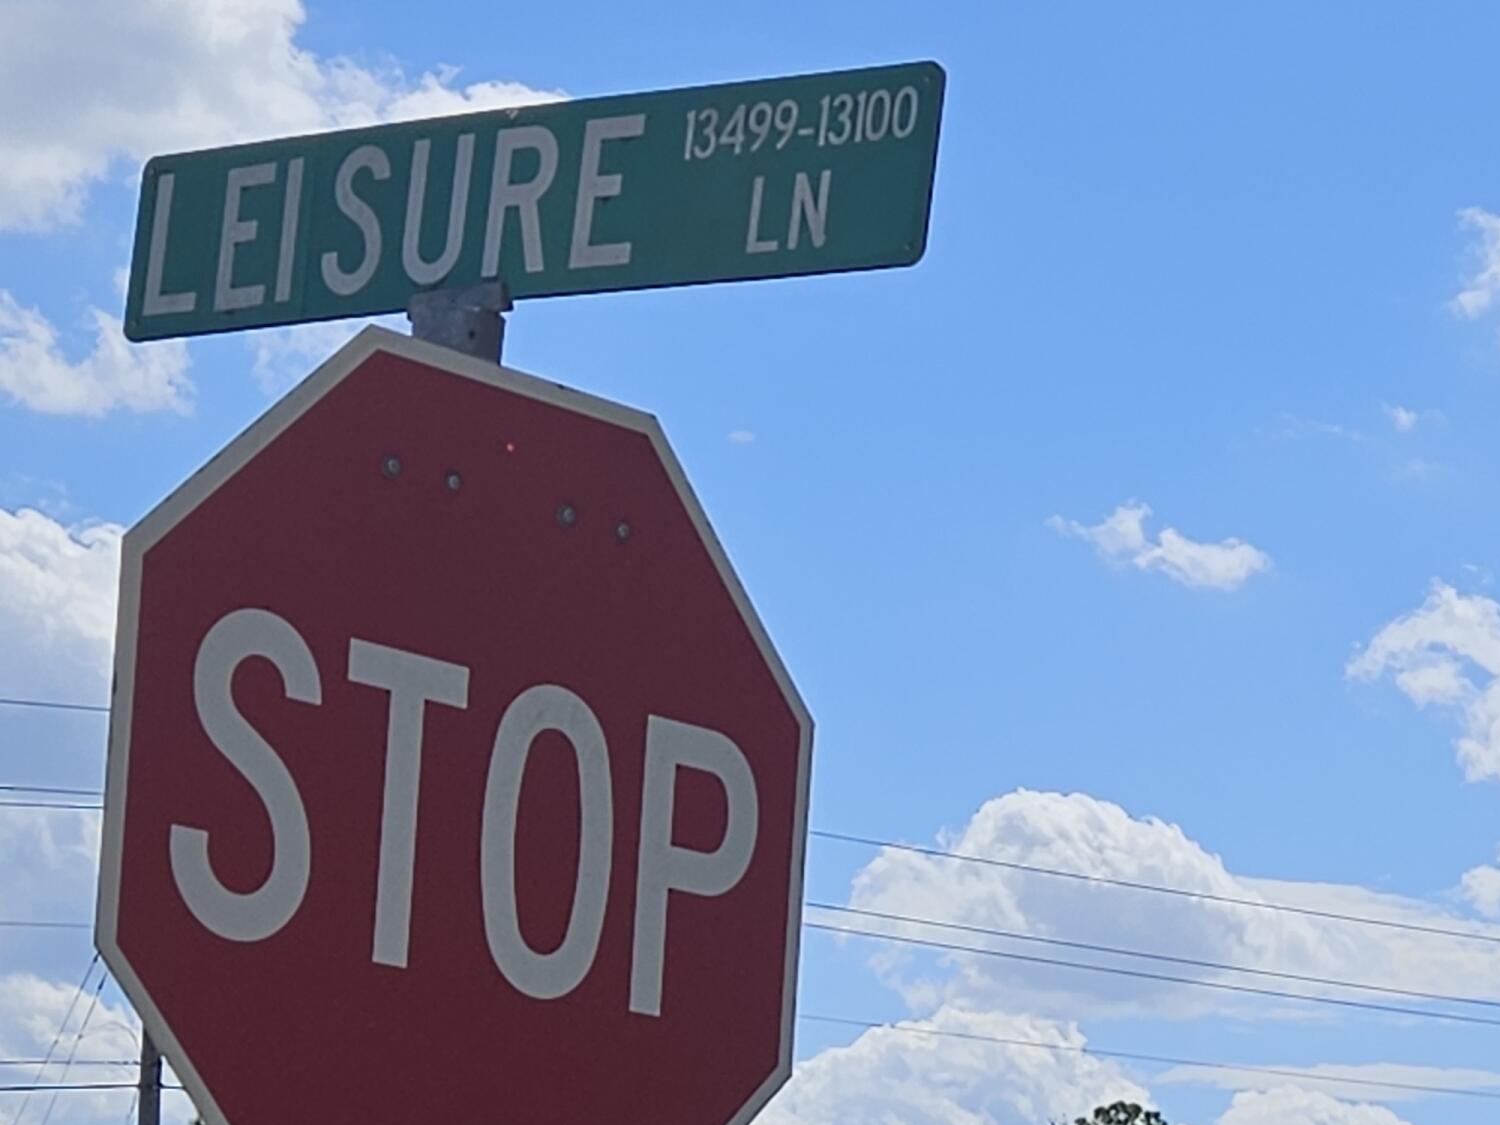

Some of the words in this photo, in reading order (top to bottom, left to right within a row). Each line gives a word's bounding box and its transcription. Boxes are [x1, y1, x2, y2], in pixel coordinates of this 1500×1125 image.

[683, 86, 919, 161] 13499-13100
[142, 113, 646, 317] LEISURE
[745, 168, 832, 255] LN
[169, 607, 759, 1016] STOP
